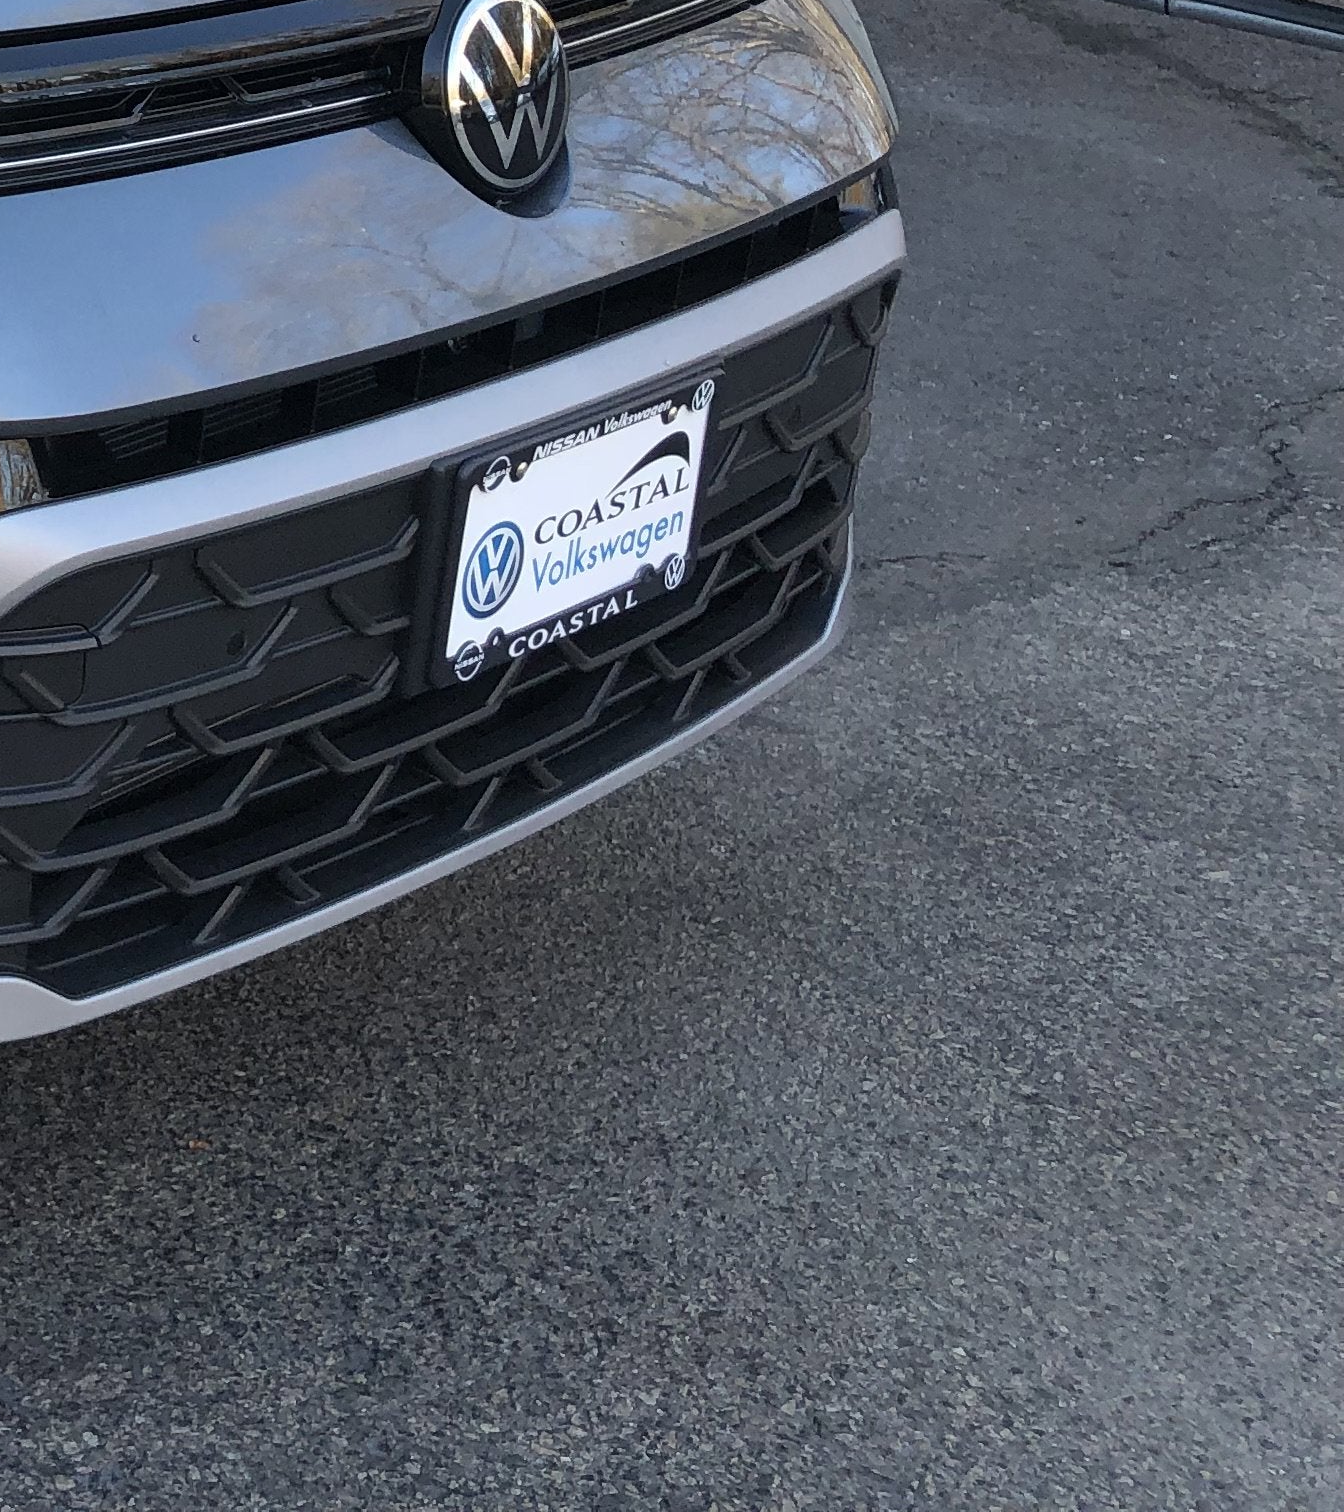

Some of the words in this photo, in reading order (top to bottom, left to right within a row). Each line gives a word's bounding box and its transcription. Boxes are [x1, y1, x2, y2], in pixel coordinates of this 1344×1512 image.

[533, 424, 601, 461] NISSAN
[604, 400, 673, 435] Volkswagen
[534, 468, 691, 545] COASTAL
[532, 510, 685, 593] Volkswagen
[508, 588, 639, 659] COASTAL
